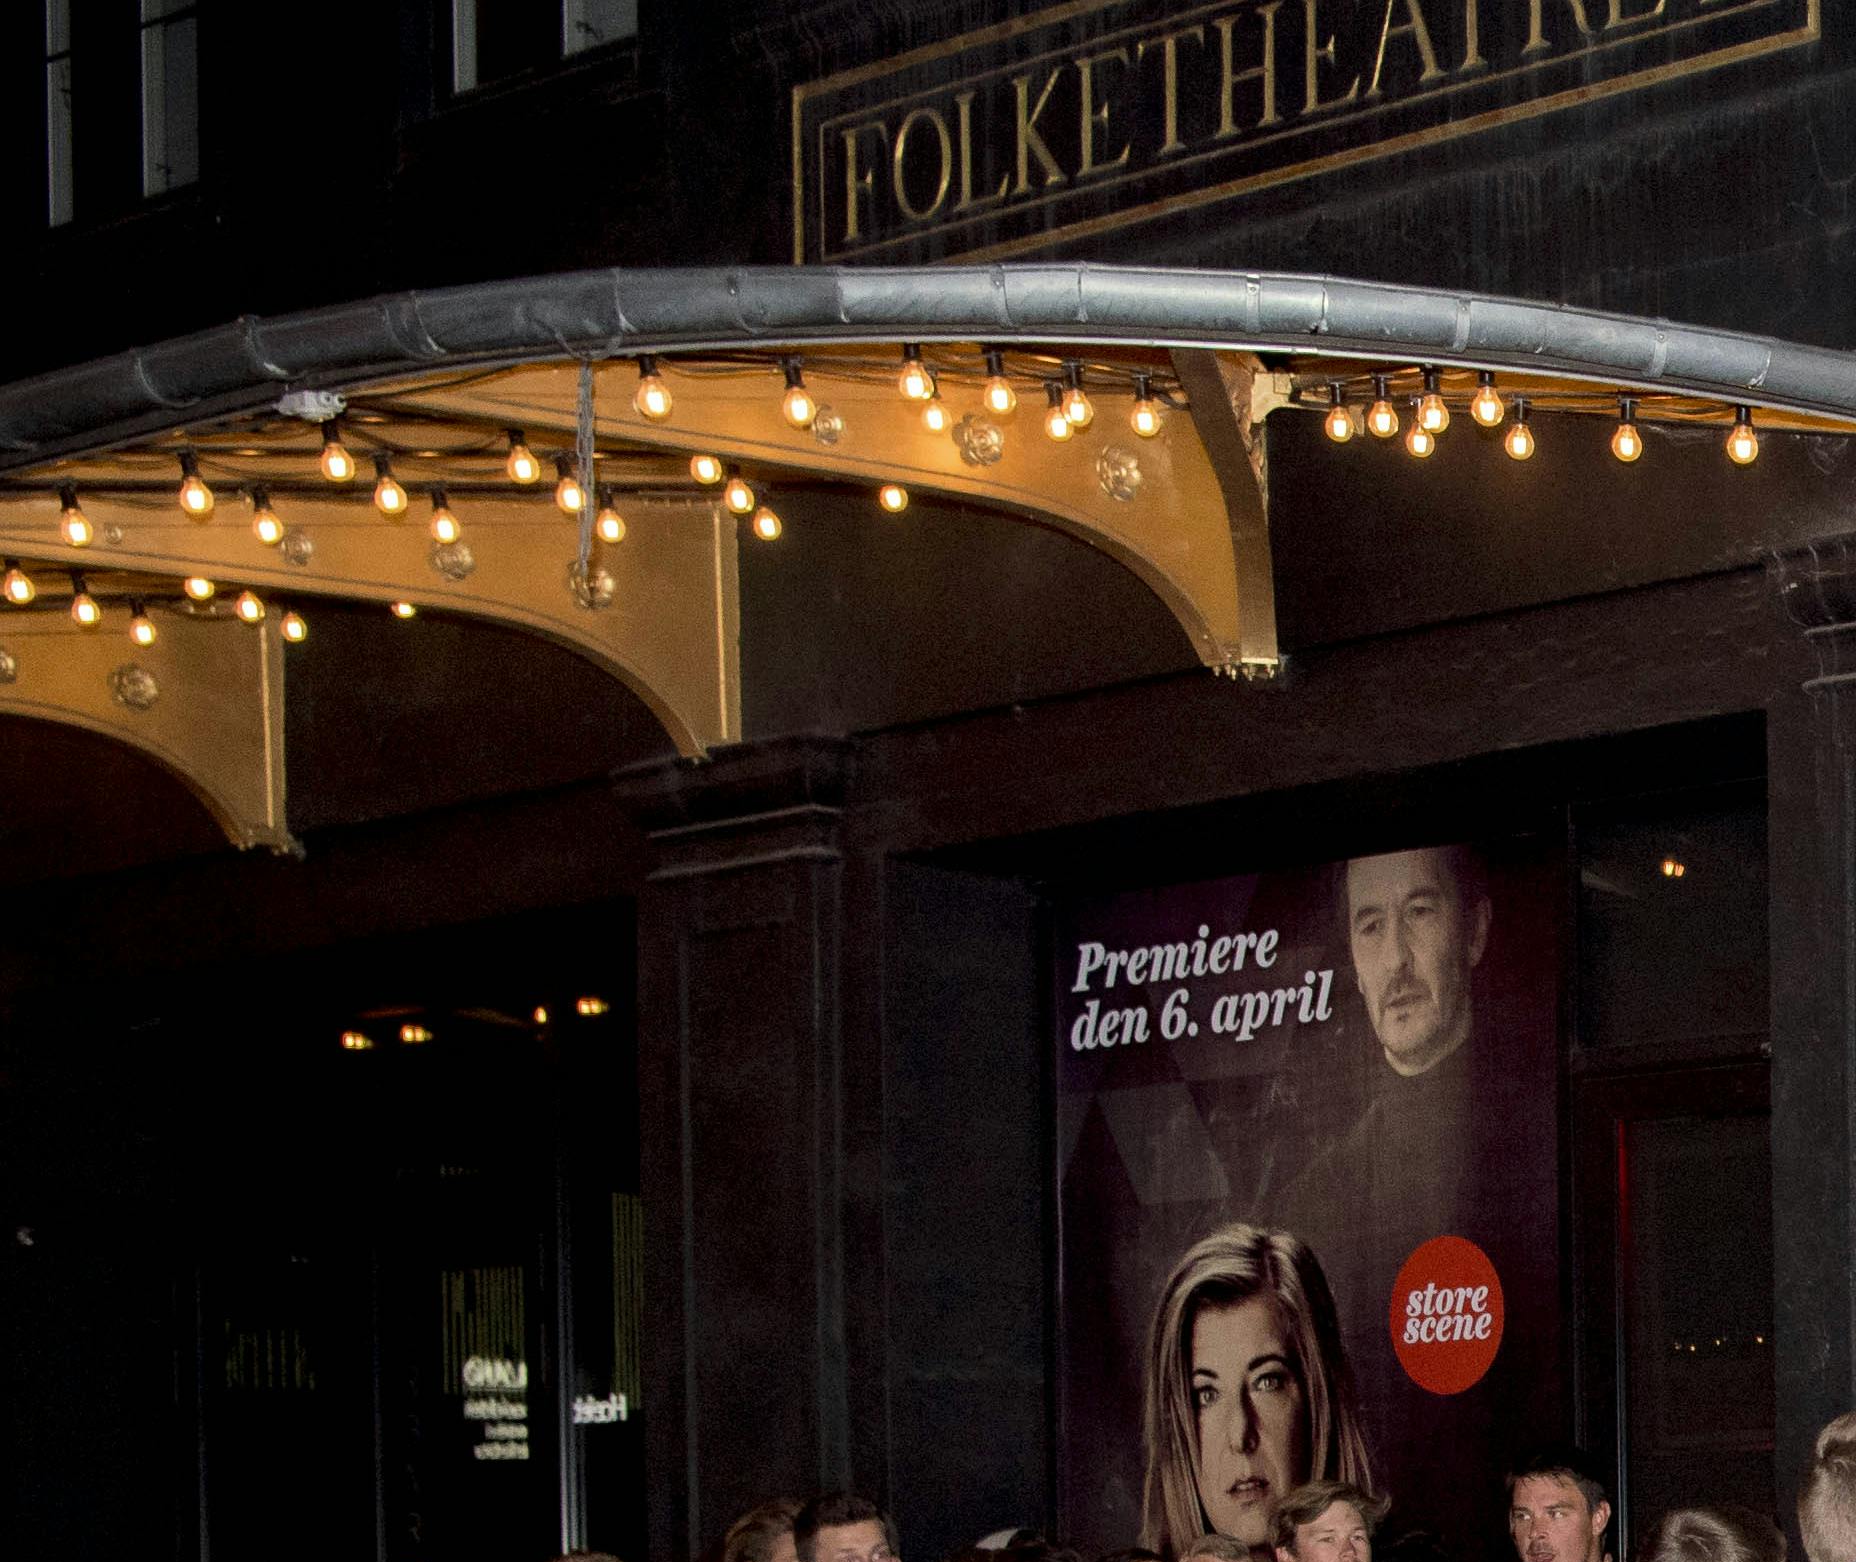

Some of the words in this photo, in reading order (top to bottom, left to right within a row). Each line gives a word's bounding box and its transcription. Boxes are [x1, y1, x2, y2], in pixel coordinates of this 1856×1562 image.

[1071, 924, 1279, 993] Premiere
[1071, 1000, 1150, 1051] den
[1160, 988, 1199, 1041] 6.
[1211, 969, 1334, 1042] april
[1405, 1282, 1489, 1317] store
[1403, 1312, 1493, 1345] scene
